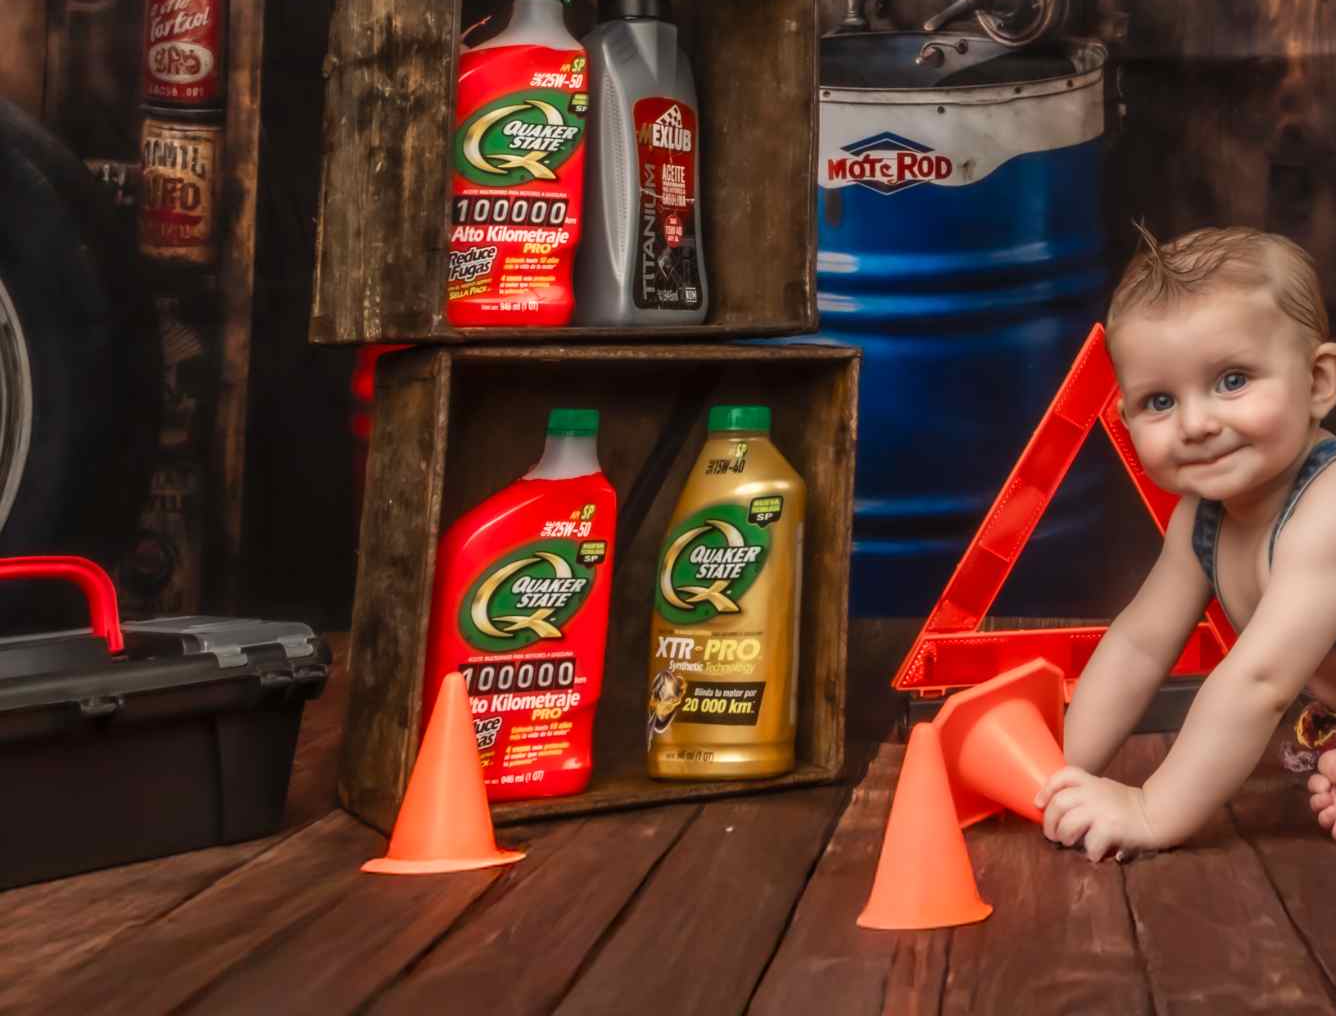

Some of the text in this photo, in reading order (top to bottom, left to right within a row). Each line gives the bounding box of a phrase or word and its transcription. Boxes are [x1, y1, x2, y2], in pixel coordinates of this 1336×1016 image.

[502, 120, 580, 139] QUAKER
[508, 137, 563, 152] STATE
[457, 198, 567, 224] 100000
[451, 225, 570, 247] Alto Kilometraje
[643, 163, 656, 301] TITANIUM
[448, 247, 497, 264] Reduce
[523, 243, 552, 254] PRO
[448, 263, 490, 281] Fugas
[756, 512, 774, 521] SP
[689, 545, 762, 564] QUAKER
[696, 563, 746, 579] STATE
[511, 576, 586, 594] QUAKER
[516, 592, 572, 608] STATE
[463, 661, 574, 692] 100000
[490, 689, 581, 712] Kilometraje
[682, 697, 700, 712] 20
[701, 697, 728, 713] 000
[531, 708, 562, 721] PRO
